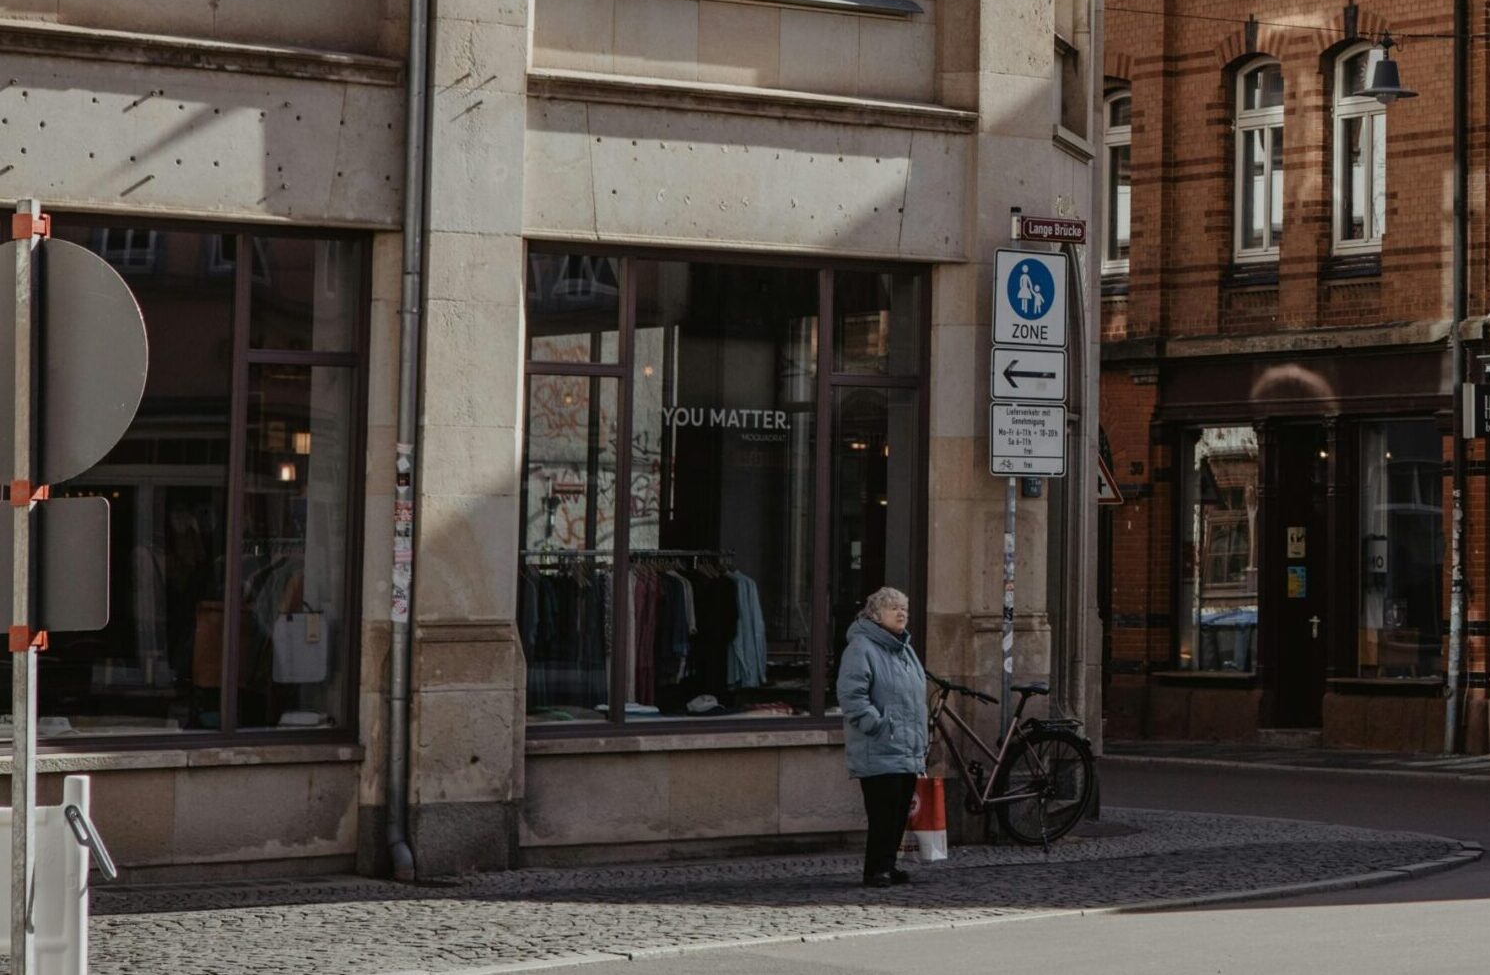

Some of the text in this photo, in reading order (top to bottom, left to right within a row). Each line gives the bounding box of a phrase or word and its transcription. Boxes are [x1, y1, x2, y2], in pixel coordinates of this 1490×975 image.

[1029, 221, 1082, 238] Lange Brücke
[1012, 323, 1048, 340] ZONE
[663, 407, 791, 430] YOU MATTER.
